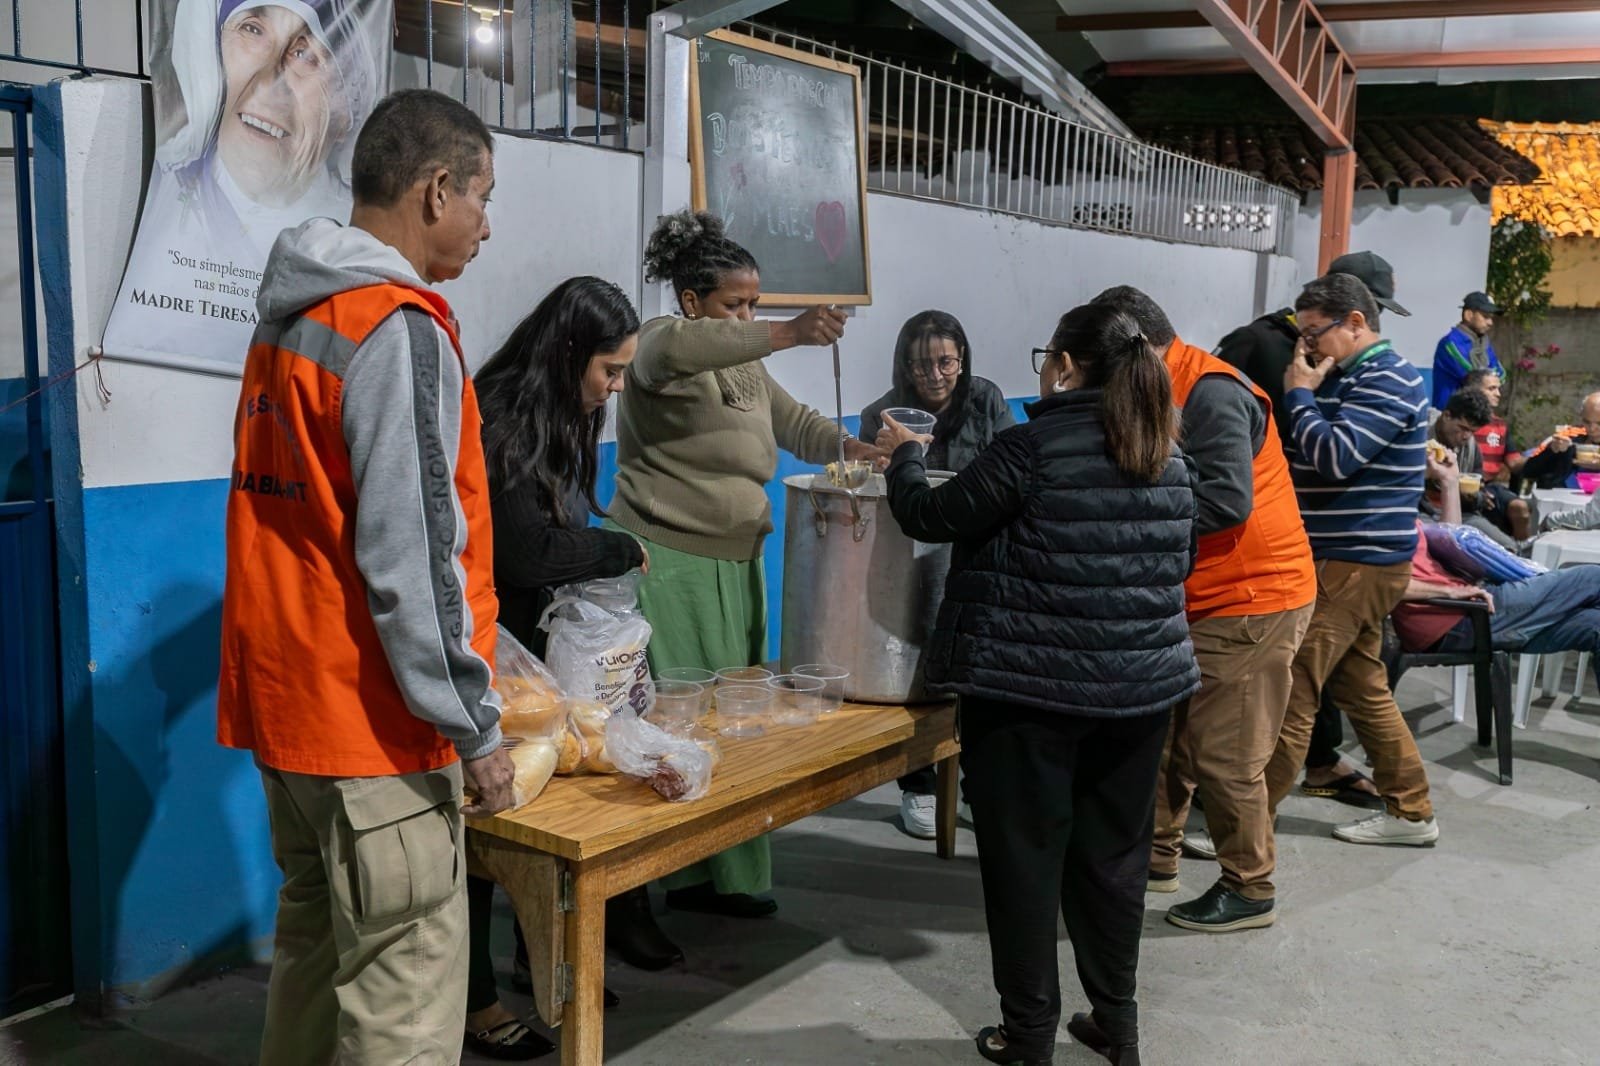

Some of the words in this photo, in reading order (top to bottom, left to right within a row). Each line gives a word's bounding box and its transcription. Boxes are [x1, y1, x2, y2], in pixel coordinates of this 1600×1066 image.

[168, 249, 196, 268] "Sou
[199, 257, 264, 282] simplesme
[194, 279, 215, 292] nas
[218, 281, 250, 298] mãos
[251, 285, 261, 299] d
[130, 288, 194, 313] MADRE
[199, 299, 257, 325] TERESA
